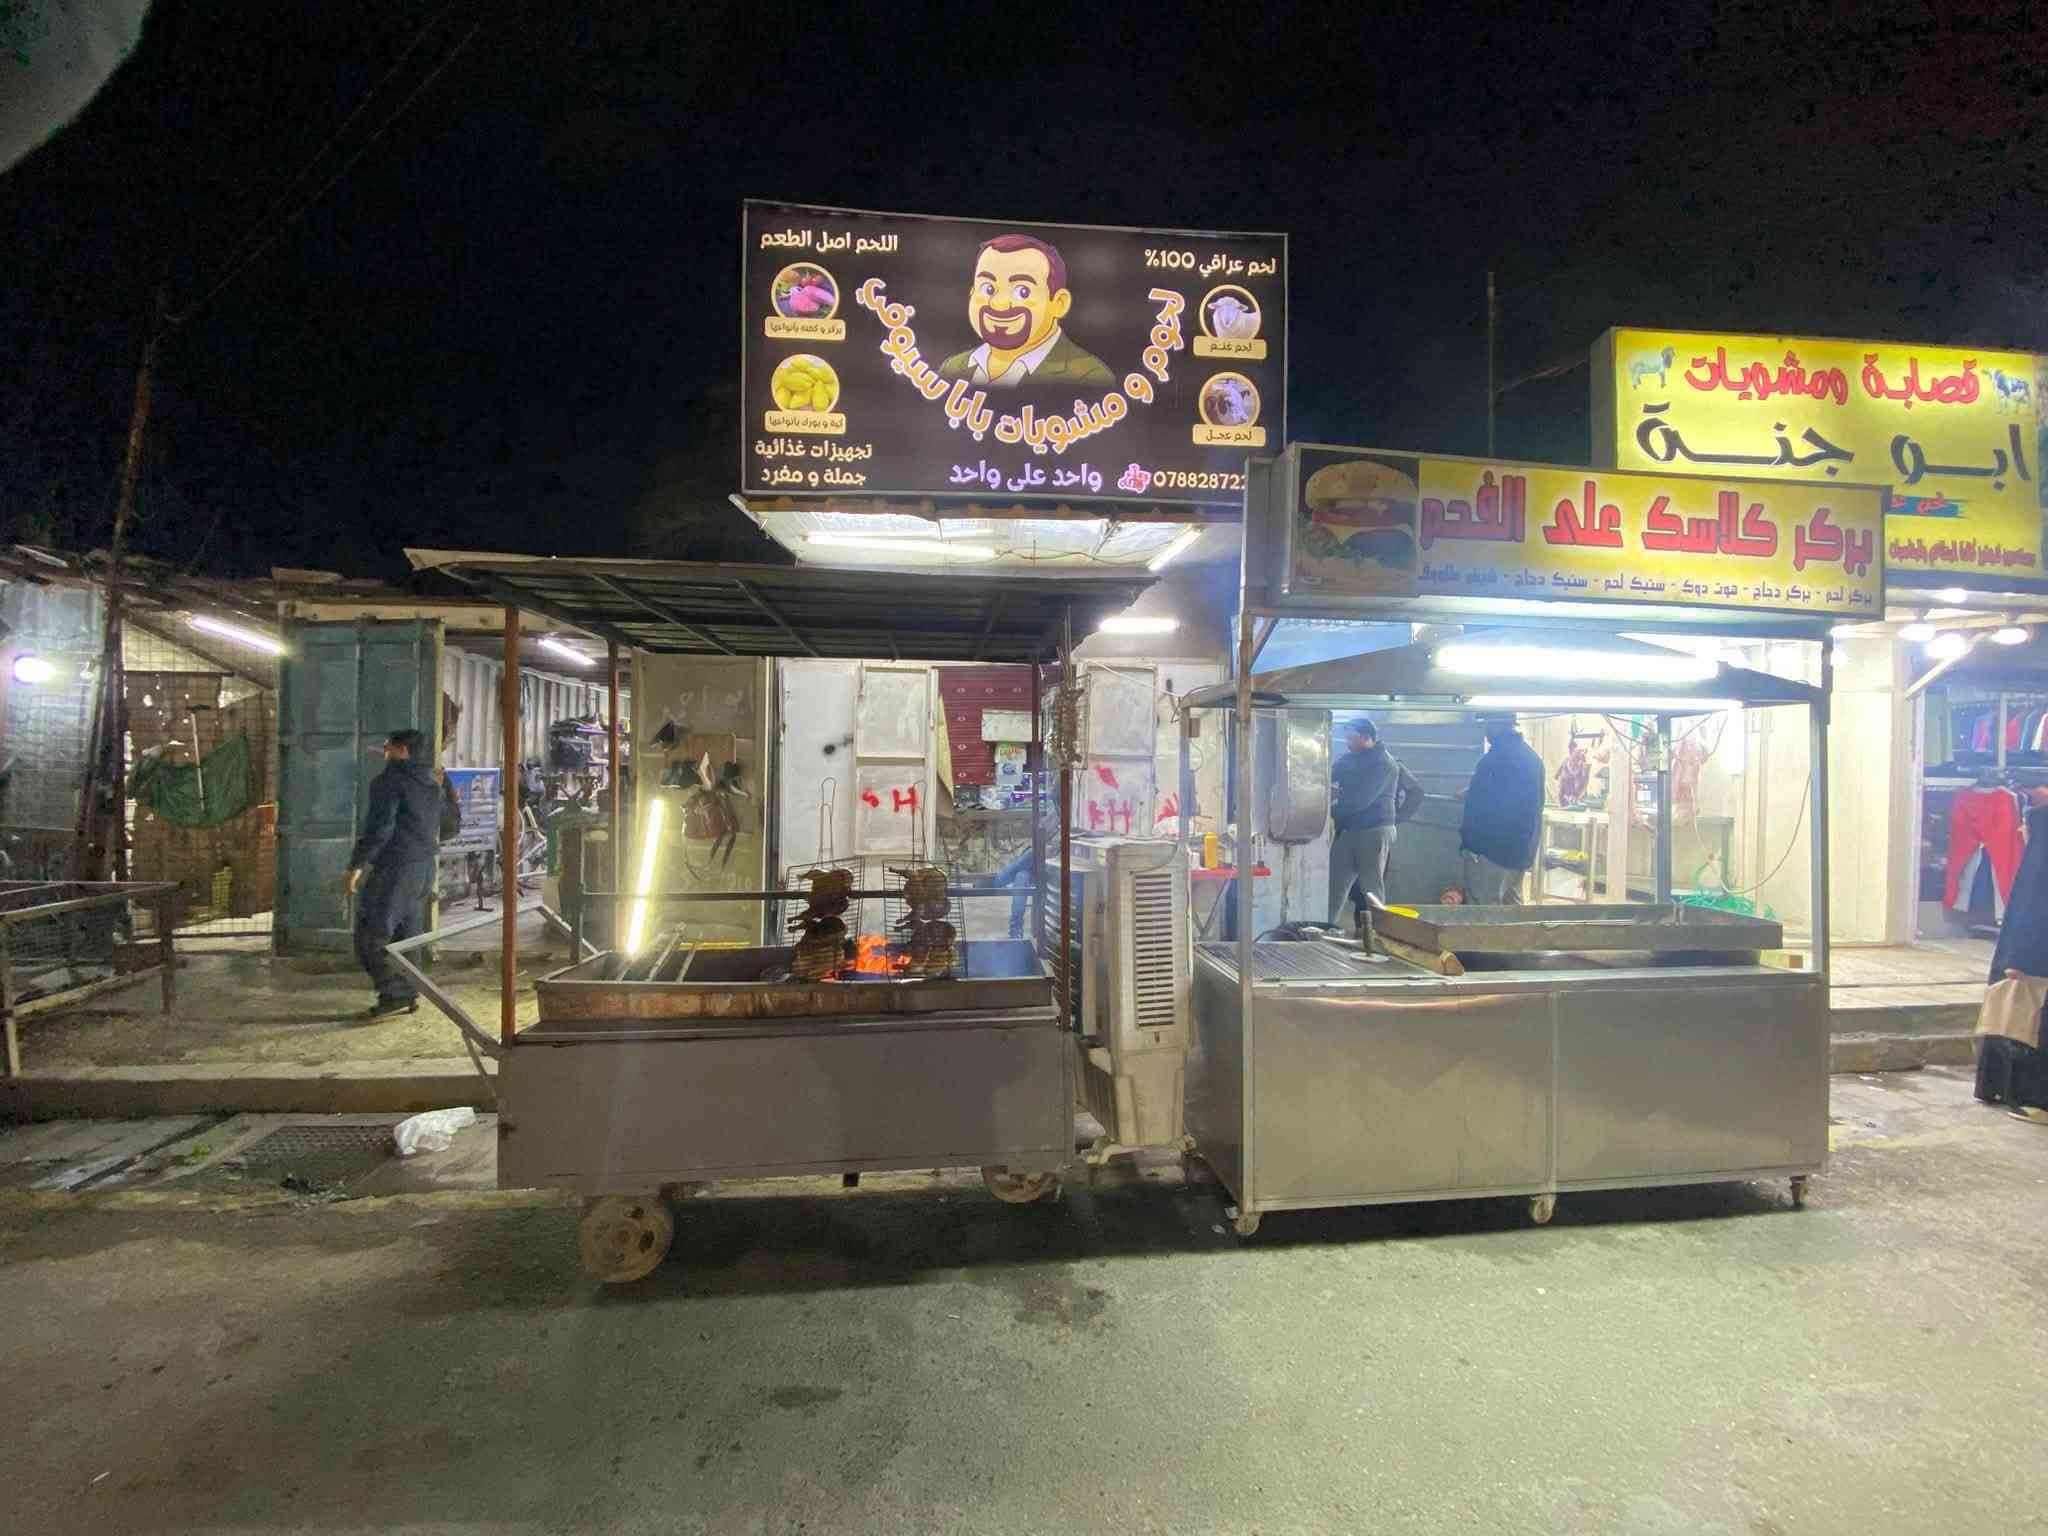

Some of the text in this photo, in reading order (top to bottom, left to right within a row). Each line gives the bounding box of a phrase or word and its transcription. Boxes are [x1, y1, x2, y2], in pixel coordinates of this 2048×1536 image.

[760, 228, 899, 254] اللحم اصل الطعم
[1199, 253, 1244, 278] عراقي
[1248, 257, 1276, 276] لحم
[1142, 288, 1185, 382] لحوم
[1209, 341, 1252, 353] لحم غنم
[1124, 371, 1153, 404] و
[1684, 346, 1981, 410] قصابة ومشويات
[944, 378, 994, 441] بابا
[994, 392, 1128, 455] مشويات
[1206, 430, 1252, 442] لحم عجل
[755, 438, 872, 462] تجهيزات غذائية
[1636, 401, 2032, 492] ابو جنة
[761, 465, 866, 487] جملة و مفرد
[949, 459, 1103, 493] واحد على واحد
[1419, 470, 1526, 550] الفحم
[1641, 491, 1778, 557] كلاسك
[1793, 508, 1873, 578] بركر
[1604, 573, 1624, 591] لحم
[1682, 579, 1708, 595] دوك
[1713, 582, 1738, 598] هوت
[1786, 585, 1811, 603] بركر
[1825, 586, 1844, 603] لحم
